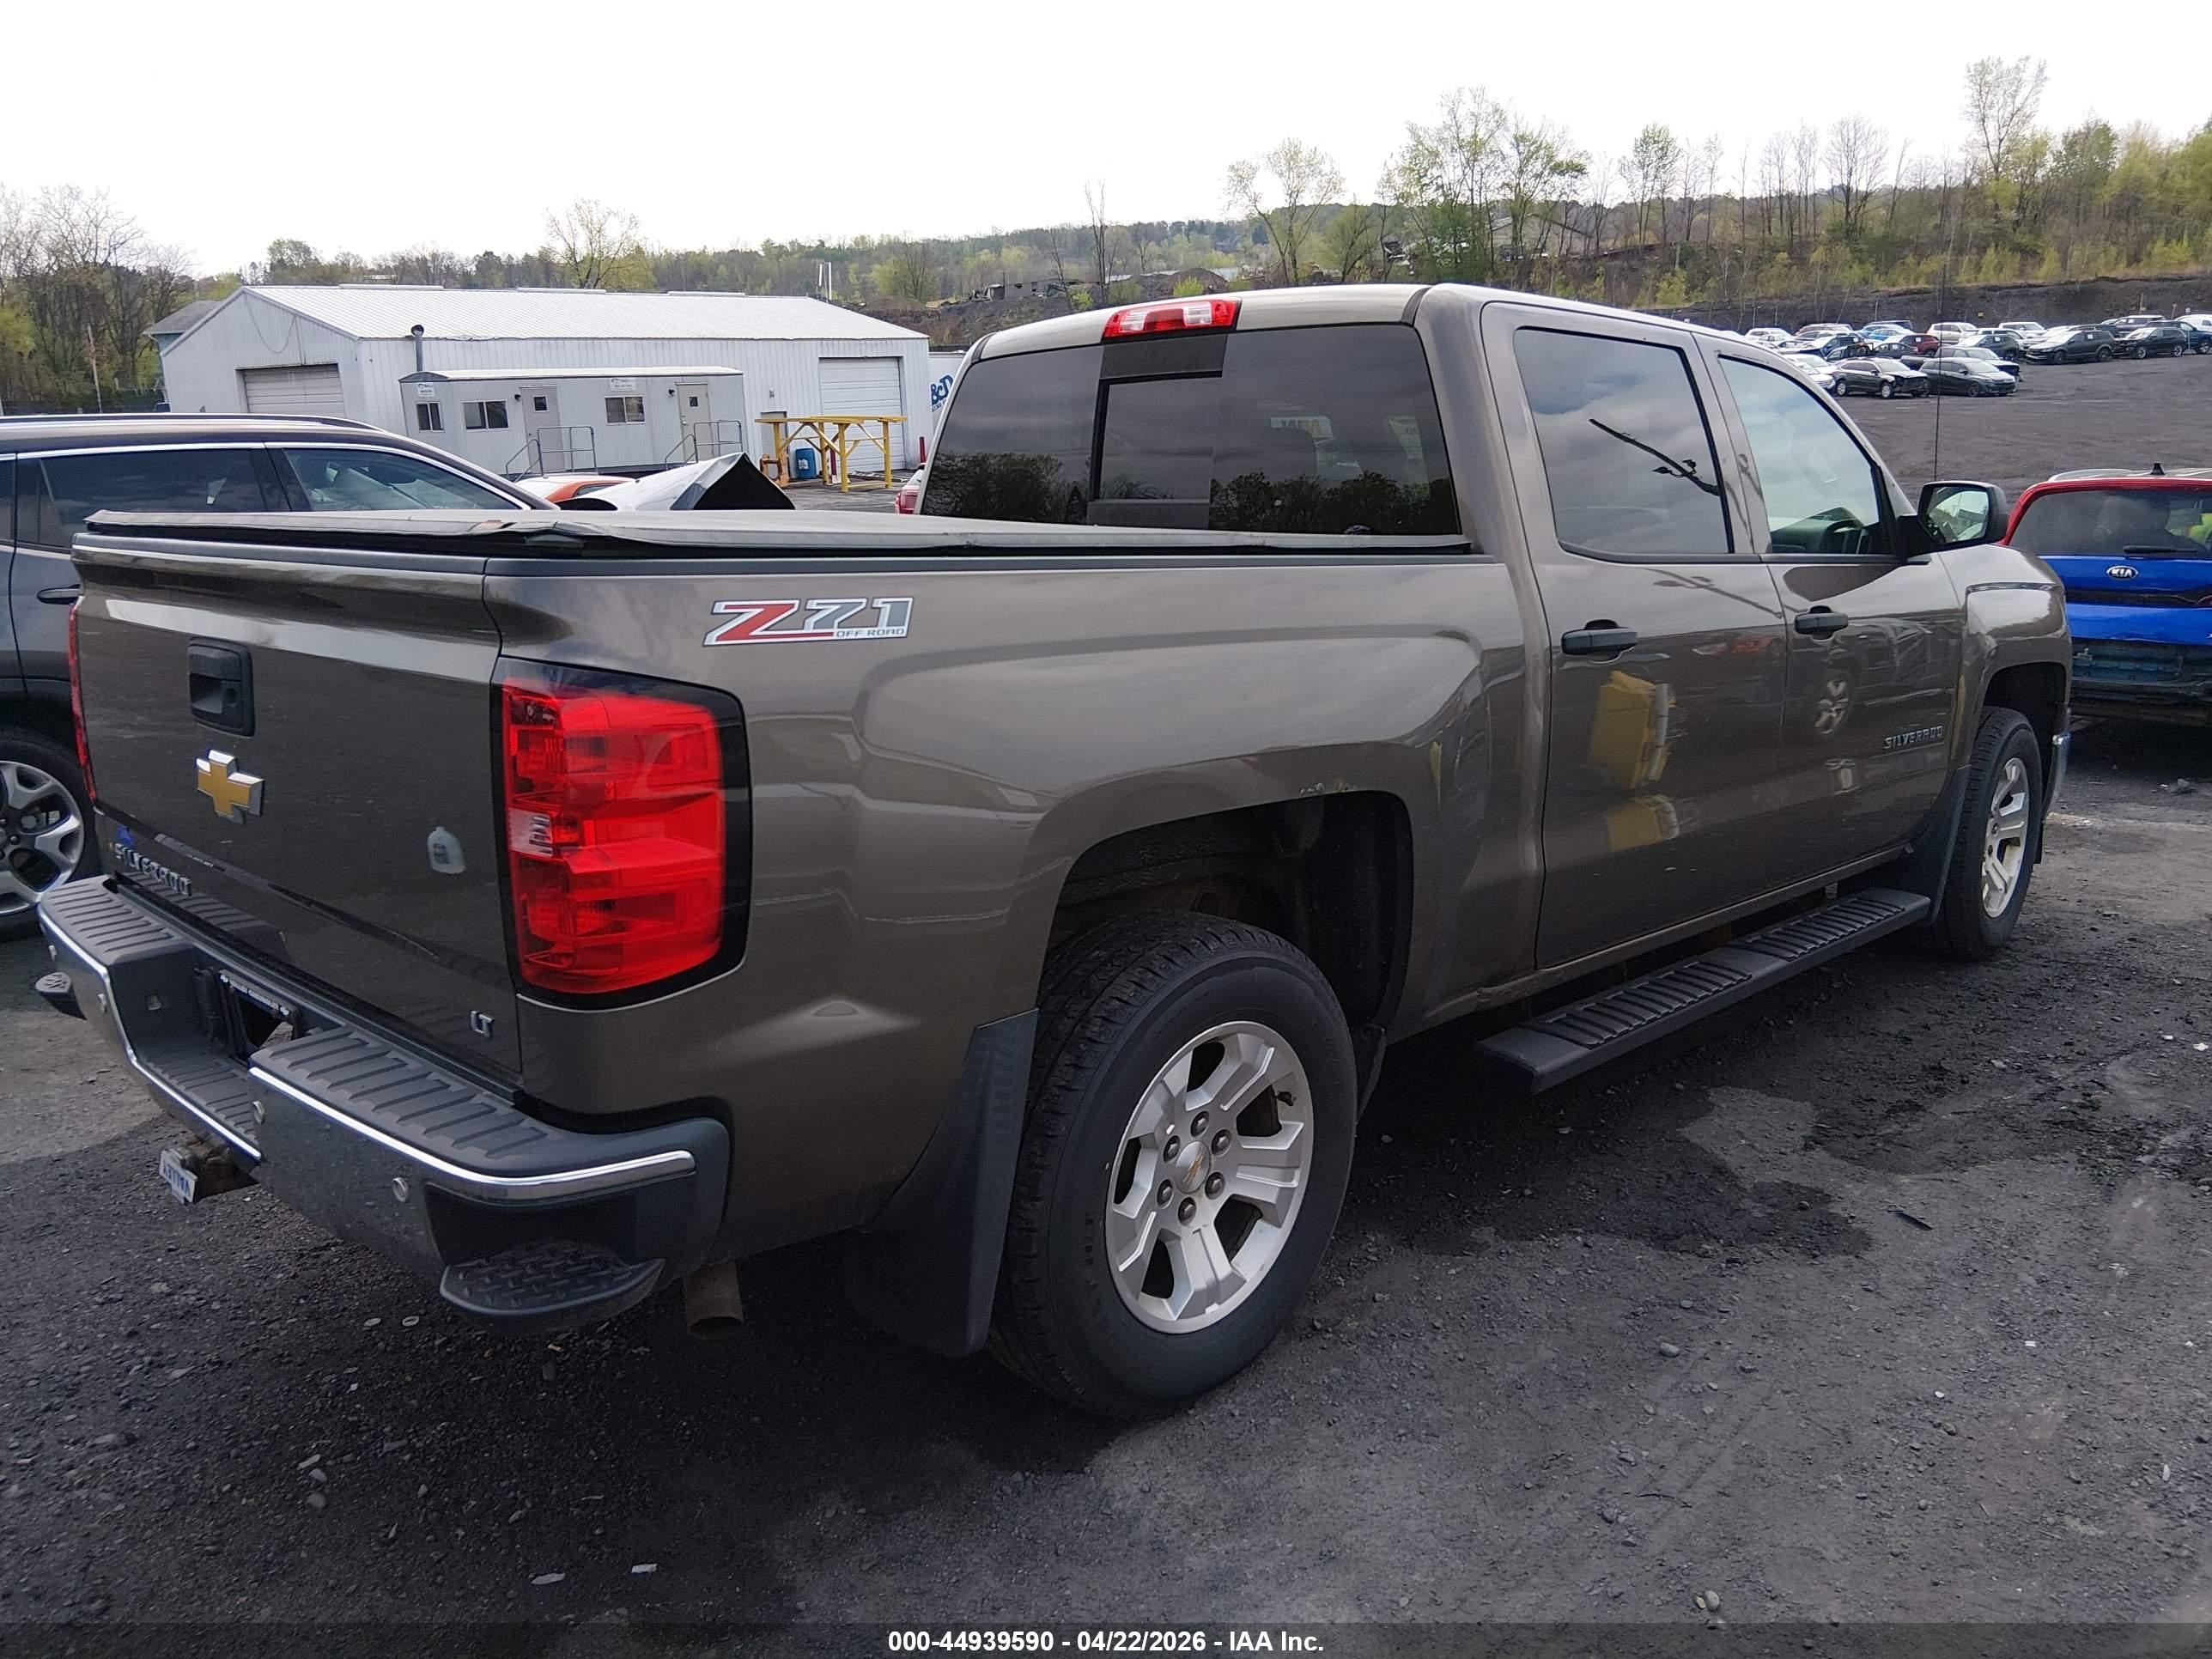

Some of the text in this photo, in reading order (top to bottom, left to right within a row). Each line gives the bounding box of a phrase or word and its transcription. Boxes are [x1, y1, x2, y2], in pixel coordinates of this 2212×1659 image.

[2112, 568, 2132, 577] KIA
[703, 597, 914, 647] Z71
[867, 628, 905, 636] ROAD
[1882, 725, 1944, 750] SILVERADO
[114, 843, 191, 896] SILVERADO
[471, 1010, 492, 1038] LT
